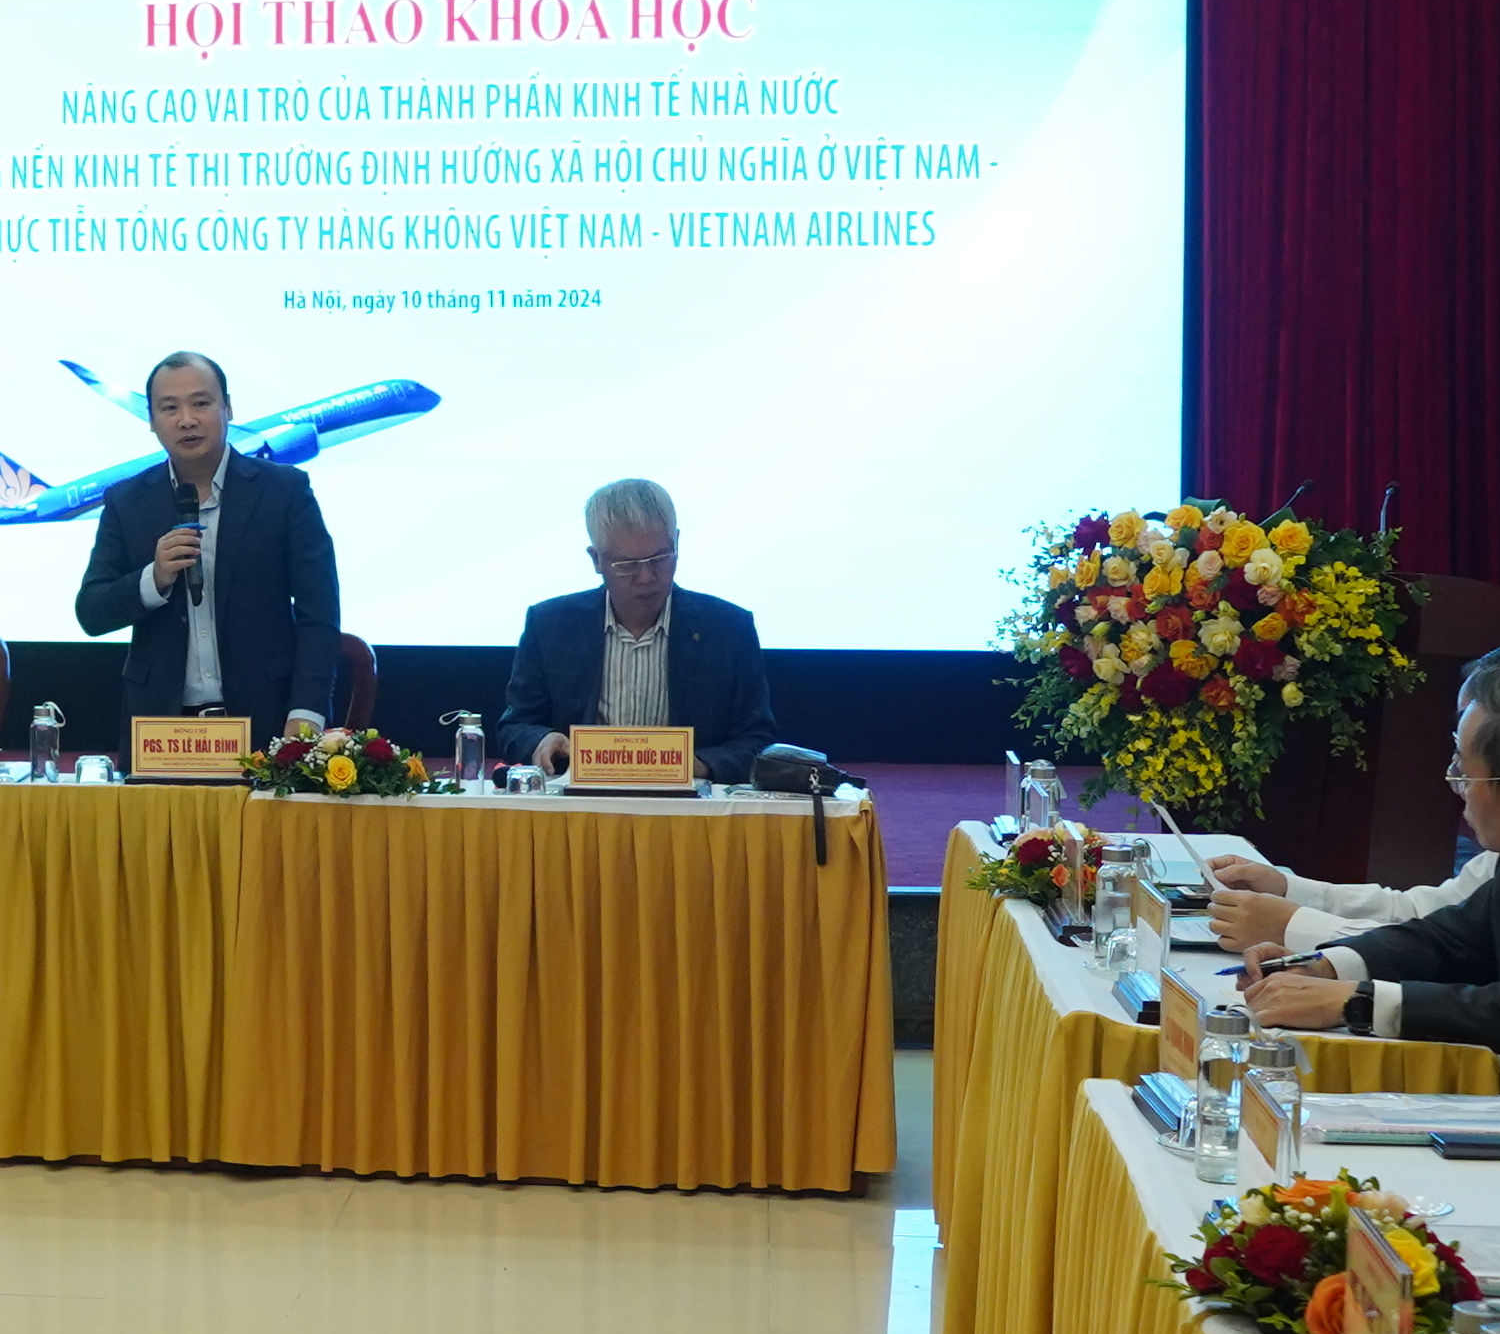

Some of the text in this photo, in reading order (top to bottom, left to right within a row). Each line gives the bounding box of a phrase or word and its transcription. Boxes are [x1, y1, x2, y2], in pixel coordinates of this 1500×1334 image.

[62, 68, 839, 125] NÂNG CAO VAI TRÒ CỦA THÀNH PHẦN KINH TẾ NHÀ NƯỚC
[11, 143, 64, 189] NỀN
[74, 153, 139, 188] KINH
[147, 139, 180, 188] TẾ
[185, 152, 229, 197] THỊ
[237, 143, 352, 187] TRƯỜNG
[360, 150, 430, 195] ĐỊNH
[441, 141, 541, 185] HƯỚNG
[550, 139, 584, 184] XÃ
[594, 139, 643, 193] HỘI
[651, 134, 708, 183] CHỦ
[718, 137, 809, 182] NGHĨA
[817, 133, 838, 181] Ở
[844, 136, 906, 190] VIỆT
[915, 143, 980, 180] NAM
[47, 206, 107, 253] TIỄN
[114, 205, 188, 253] TỔNG
[196, 208, 269, 252] CÔNG
[276, 215, 309, 251] TY
[318, 207, 395, 251] HÀNG
[404, 206, 501, 250] KHÔNG
[509, 205, 570, 259] VIỆT
[579, 212, 643, 249] NAM
[668, 211, 796, 248] VIETNAM
[805, 209, 936, 247] AIRLINES
[283, 288, 602, 315] Hà Nội, ngày 10 tháng 11 năm 2024
[143, 738, 165, 753] PGS.
[167, 738, 179, 753] TS
[580, 749, 592, 765] TS
[595, 745, 633, 765] NGUYỄN
[636, 747, 657, 765] ĐỨC
